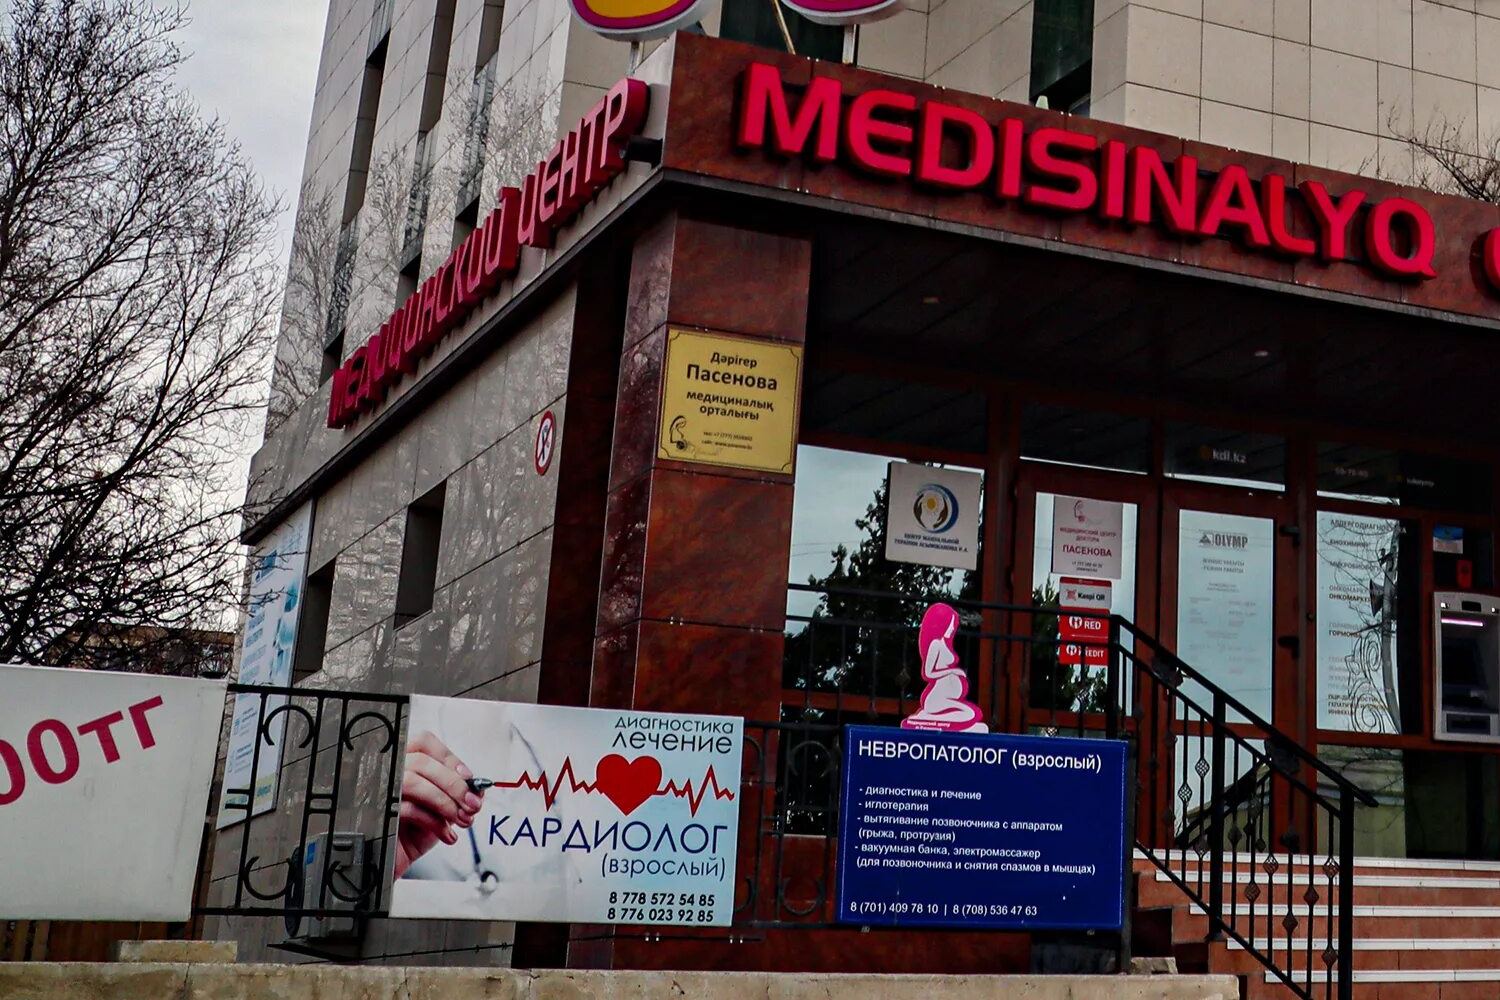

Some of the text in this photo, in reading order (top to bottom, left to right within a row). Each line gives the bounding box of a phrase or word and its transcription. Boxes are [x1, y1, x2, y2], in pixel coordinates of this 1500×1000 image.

[517, 78, 649, 249] ЦЕНТР
[737, 61, 1438, 280] MEDISINALYQ
[710, 352, 758, 370] Дәрігер
[686, 363, 778, 391] Пасенова
[686, 390, 774, 412] медициналық
[699, 405, 760, 421] орталығы
[1214, 533, 1249, 549] OLYMP
[1062, 544, 1113, 558] ПАСЕНОВА
[1083, 620, 1102, 630] RED
[615, 716, 734, 735] диагностика
[612, 731, 733, 754] лечение
[858, 740, 1102, 774] НЕВРОПАТОЛОГ (взрослый)
[865, 786, 982, 800] диагностика и лечение
[864, 800, 929, 812] иглотерапия
[863, 815, 1063, 832] вытягивание позвоночника с аппаратом
[489, 815, 728, 854] КАРДИОЛОГ
[858, 827, 956, 843] (грыжа, протрузия)
[861, 843, 1041, 860] вакуумная банка, электромассажер
[600, 853, 726, 881] (взрослый)
[856, 856, 1096, 876] (для позвоночника и снятия спазмов в мышцах)
[609, 891, 715, 907] 8 778 572 54 85
[607, 907, 714, 922] 8 776 023 92 85
[850, 902, 1037, 917] 8 (701) 409 78 10 8 (708) 536 47 63
